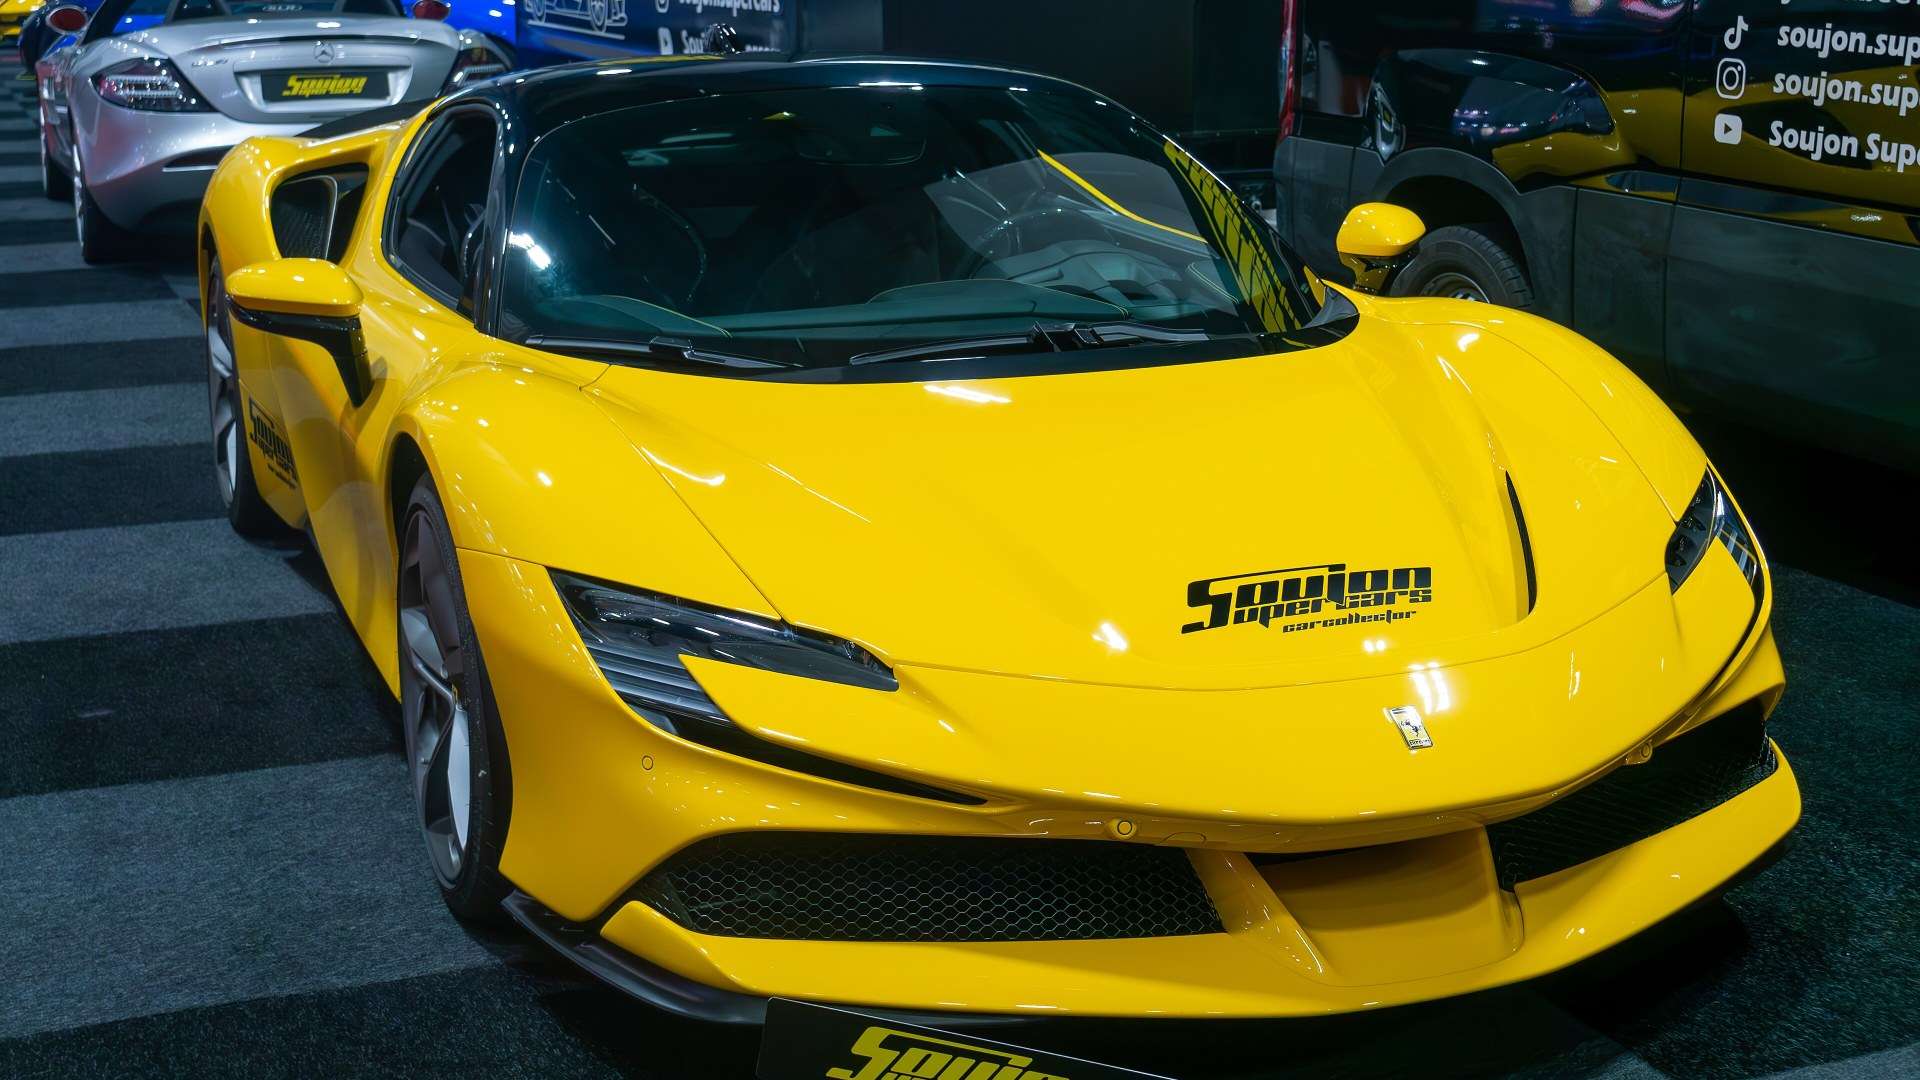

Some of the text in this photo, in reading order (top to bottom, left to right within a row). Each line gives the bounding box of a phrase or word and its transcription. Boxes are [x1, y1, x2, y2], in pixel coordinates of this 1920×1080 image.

[1773, 71, 1920, 116] soujon.sup
[1769, 120, 1920, 173] Soujon Sup
[1181, 563, 1432, 634] Soujon
[1282, 609, 1417, 633] carcollector
